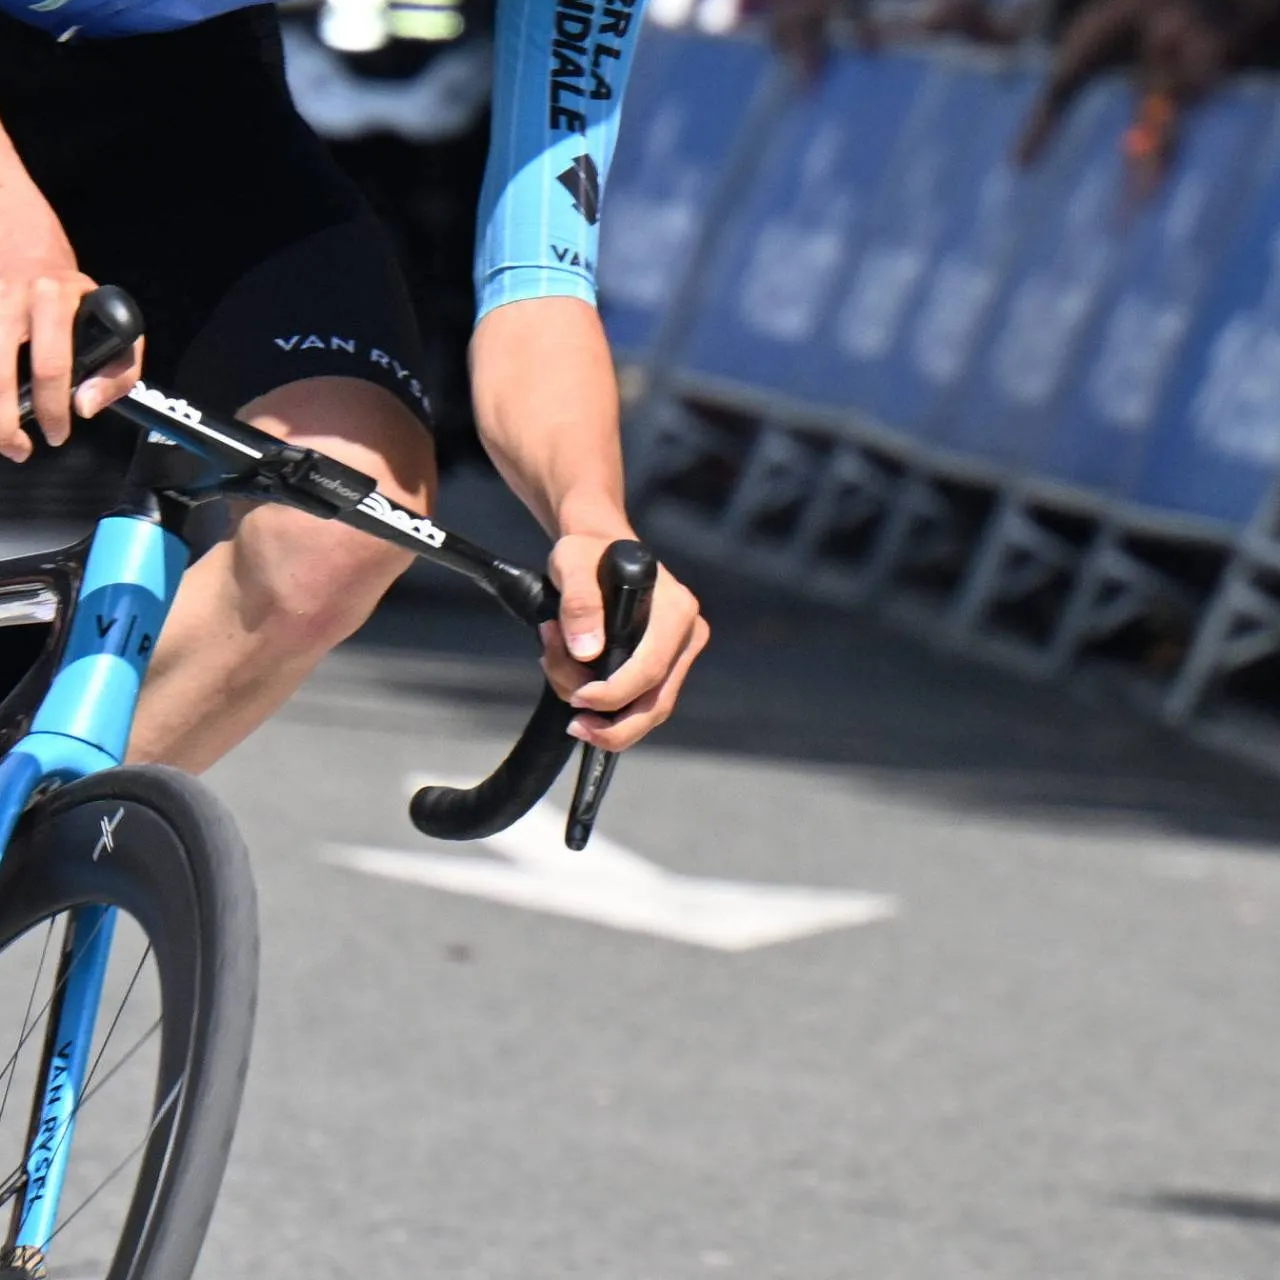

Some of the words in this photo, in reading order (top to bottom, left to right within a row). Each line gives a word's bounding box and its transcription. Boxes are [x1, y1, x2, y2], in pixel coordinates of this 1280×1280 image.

[587, 42, 621, 101] LA
[274, 334, 356, 354] VAN
[308, 470, 363, 505] wahoo
[46, 1039, 73, 1107] VAN
